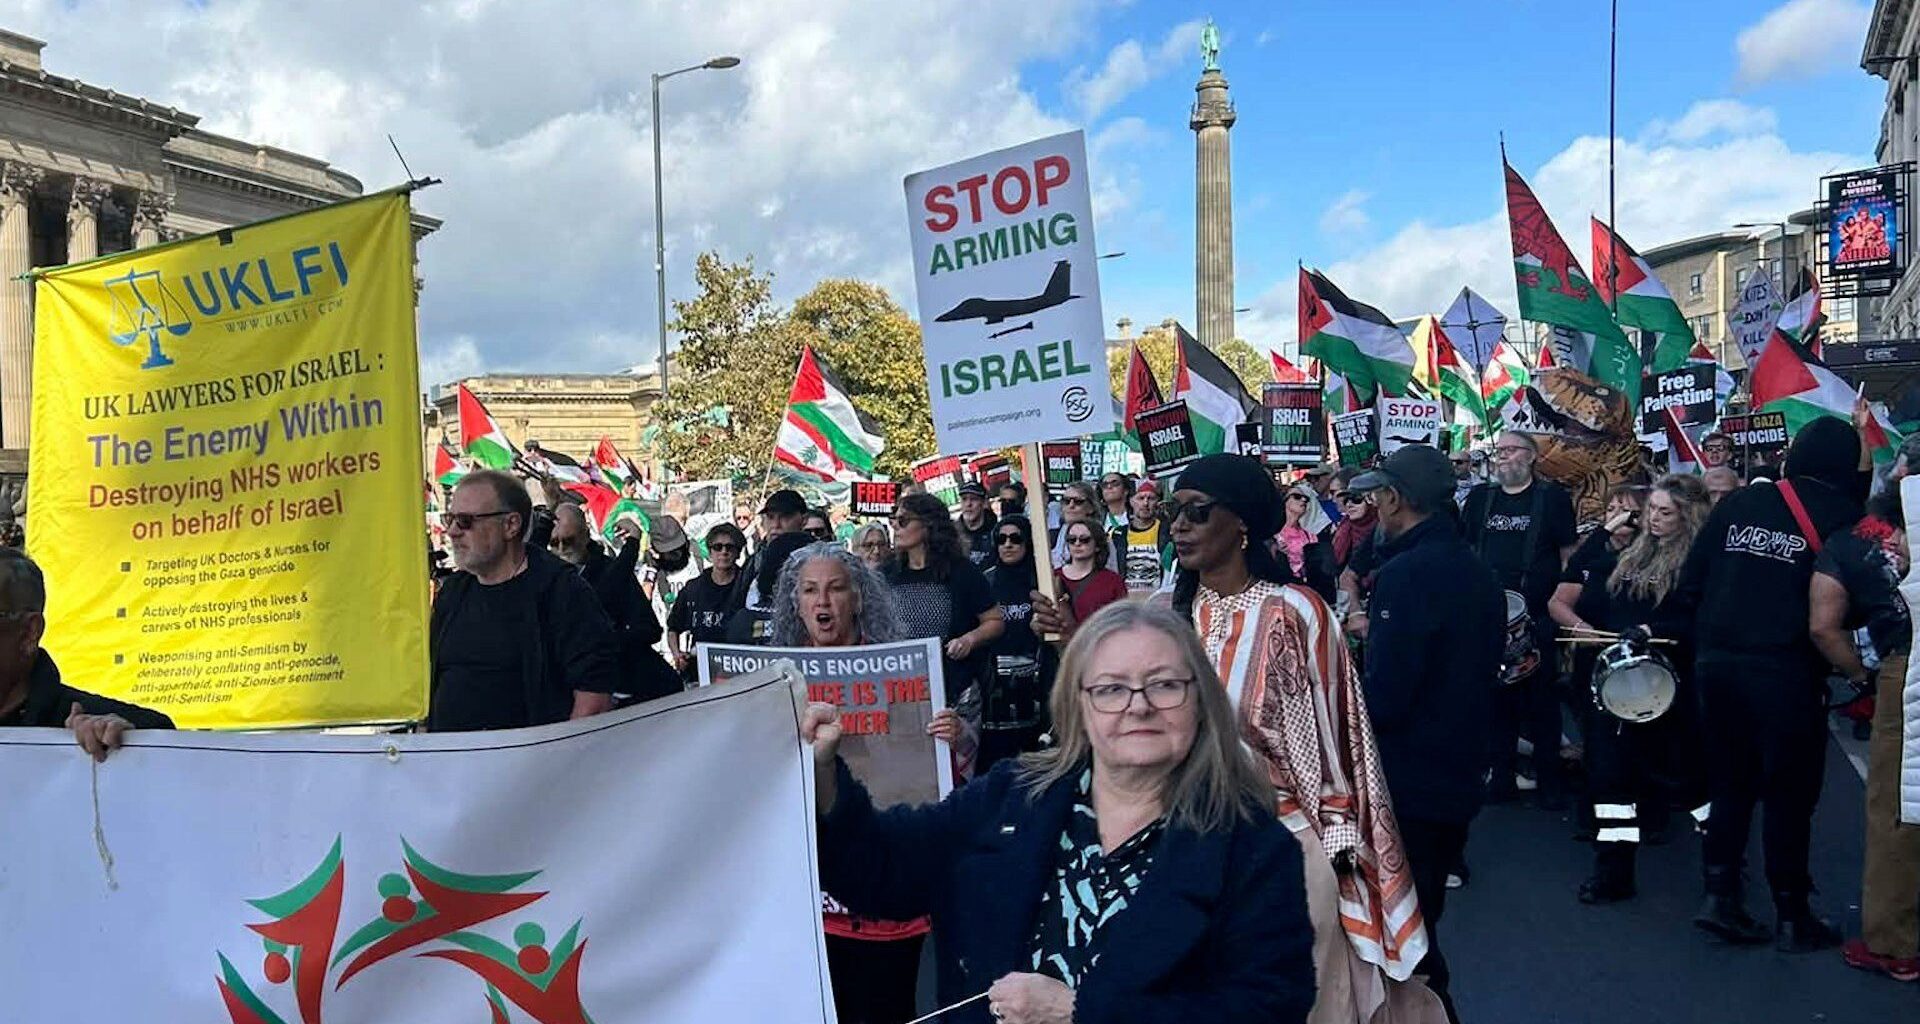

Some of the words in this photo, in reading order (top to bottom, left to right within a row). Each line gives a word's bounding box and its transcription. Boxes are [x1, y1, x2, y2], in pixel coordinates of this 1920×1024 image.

[924, 155, 1070, 232] STOP
[930, 213, 1077, 276] ARMING
[183, 242, 348, 316] UKLFI
[940, 340, 1091, 398] ISRAEL
[84, 396, 120, 420] UK
[127, 378, 236, 415] LAWYERS
[241, 369, 286, 399] FOR
[291, 348, 370, 388] ISRAEL
[1658, 374, 1695, 392] Free
[1388, 403, 1436, 417] STOP
[1644, 388, 1713, 413] Palestine
[1272, 409, 1312, 425] ISRAEL
[1386, 418, 1435, 429] ARMING
[88, 434, 152, 468] The
[164, 419, 270, 462] Enemy
[279, 394, 384, 442] Within
[1148, 425, 1185, 447] ISRAEL
[1732, 428, 1786, 445] ENOCIDE
[89, 476, 223, 508] Destroying
[230, 463, 281, 494] NHS
[288, 451, 380, 483] workers
[857, 483, 896, 502] FREE
[132, 522, 162, 541] on
[172, 504, 244, 536] behalf
[251, 501, 274, 526] of
[281, 489, 343, 523] Israel
[147, 558, 198, 573] Targeting
[200, 557, 216, 566] UK
[219, 551, 260, 564] Doctors
[264, 547, 272, 559] &
[312, 540, 331, 552] for
[143, 574, 195, 588] opposing
[199, 571, 216, 583] the
[220, 568, 245, 579] Gaza
[249, 561, 295, 579] genocide
[142, 604, 188, 618] Actively
[189, 600, 247, 615] destroying
[250, 597, 268, 609] the
[270, 594, 297, 605] lives
[300, 592, 308, 602] &
[142, 622, 181, 633] careers
[185, 618, 197, 629] of
[200, 615, 225, 628] NHS
[228, 609, 301, 628] professionals
[138, 651, 212, 665] Weaponising
[216, 644, 290, 658] anti-Semitism
[293, 641, 307, 654] by
[713, 655, 778, 673] “ENOU
[802, 659, 820, 675] IS
[137, 664, 203, 679] deliberately
[205, 661, 261, 675] conflating
[215, 675, 285, 689] anti-Zionism
[287, 669, 344, 683] sentiment
[152, 692, 232, 705] anti-Semitism
[852, 680, 877, 705] IS
[884, 675, 928, 704] THE
